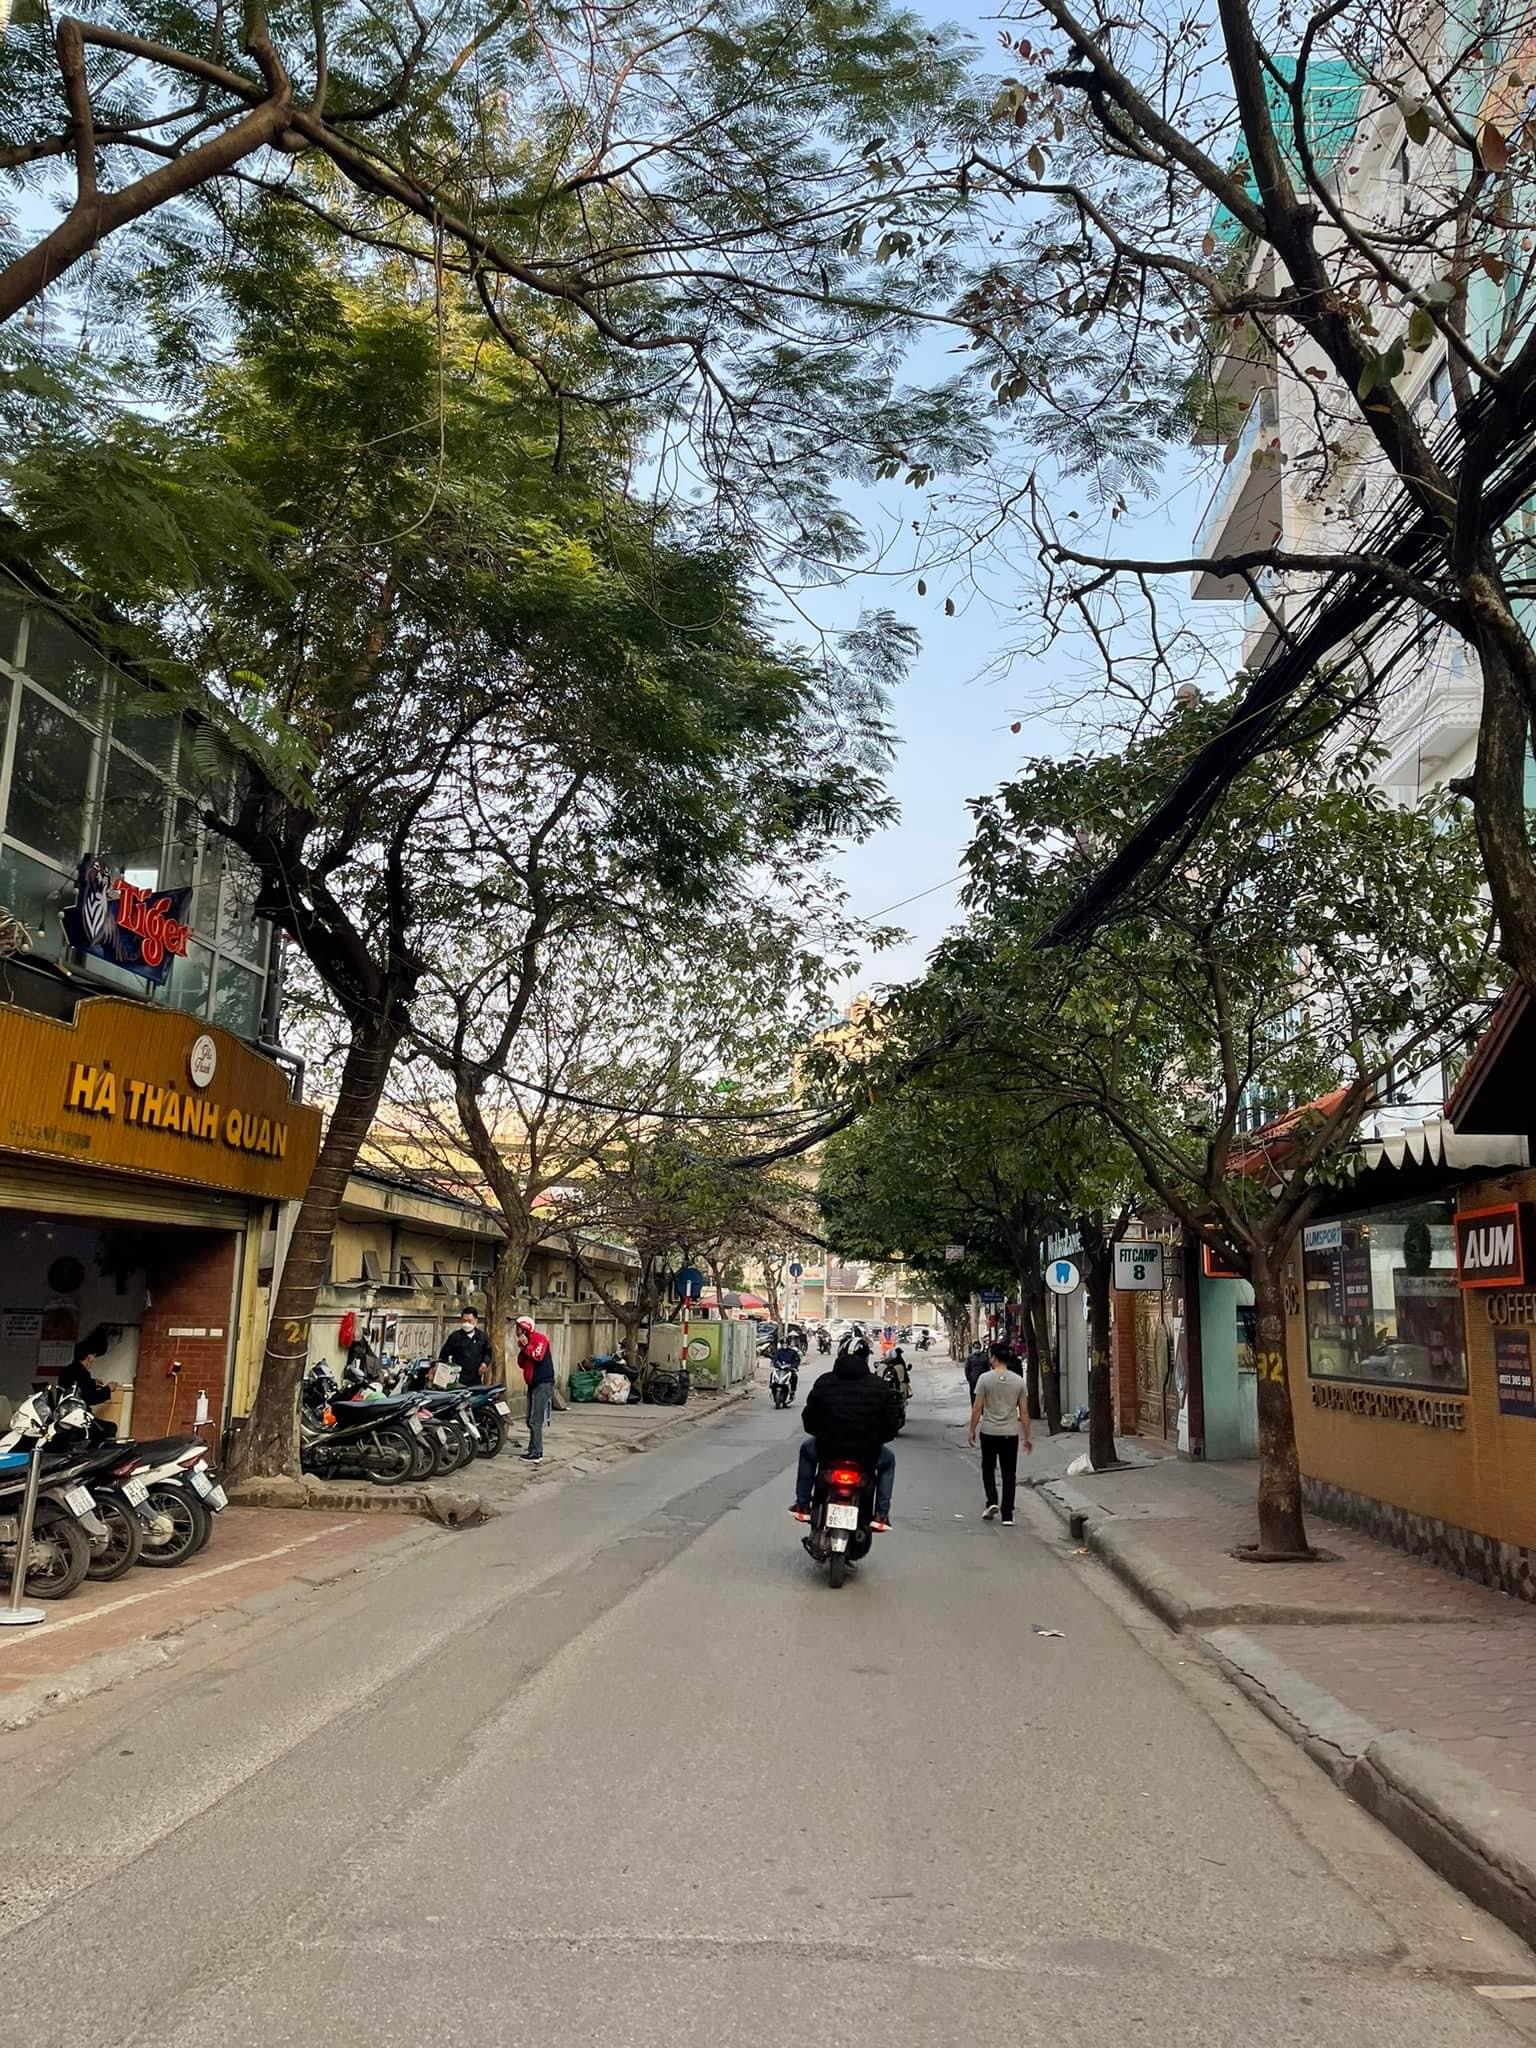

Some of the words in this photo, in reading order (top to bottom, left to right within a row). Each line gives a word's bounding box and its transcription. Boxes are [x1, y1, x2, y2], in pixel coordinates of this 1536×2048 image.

[112, 879, 194, 967] Tiger
[1463, 1223, 1515, 1269] AUM
[1133, 1264, 1146, 1281] 8
